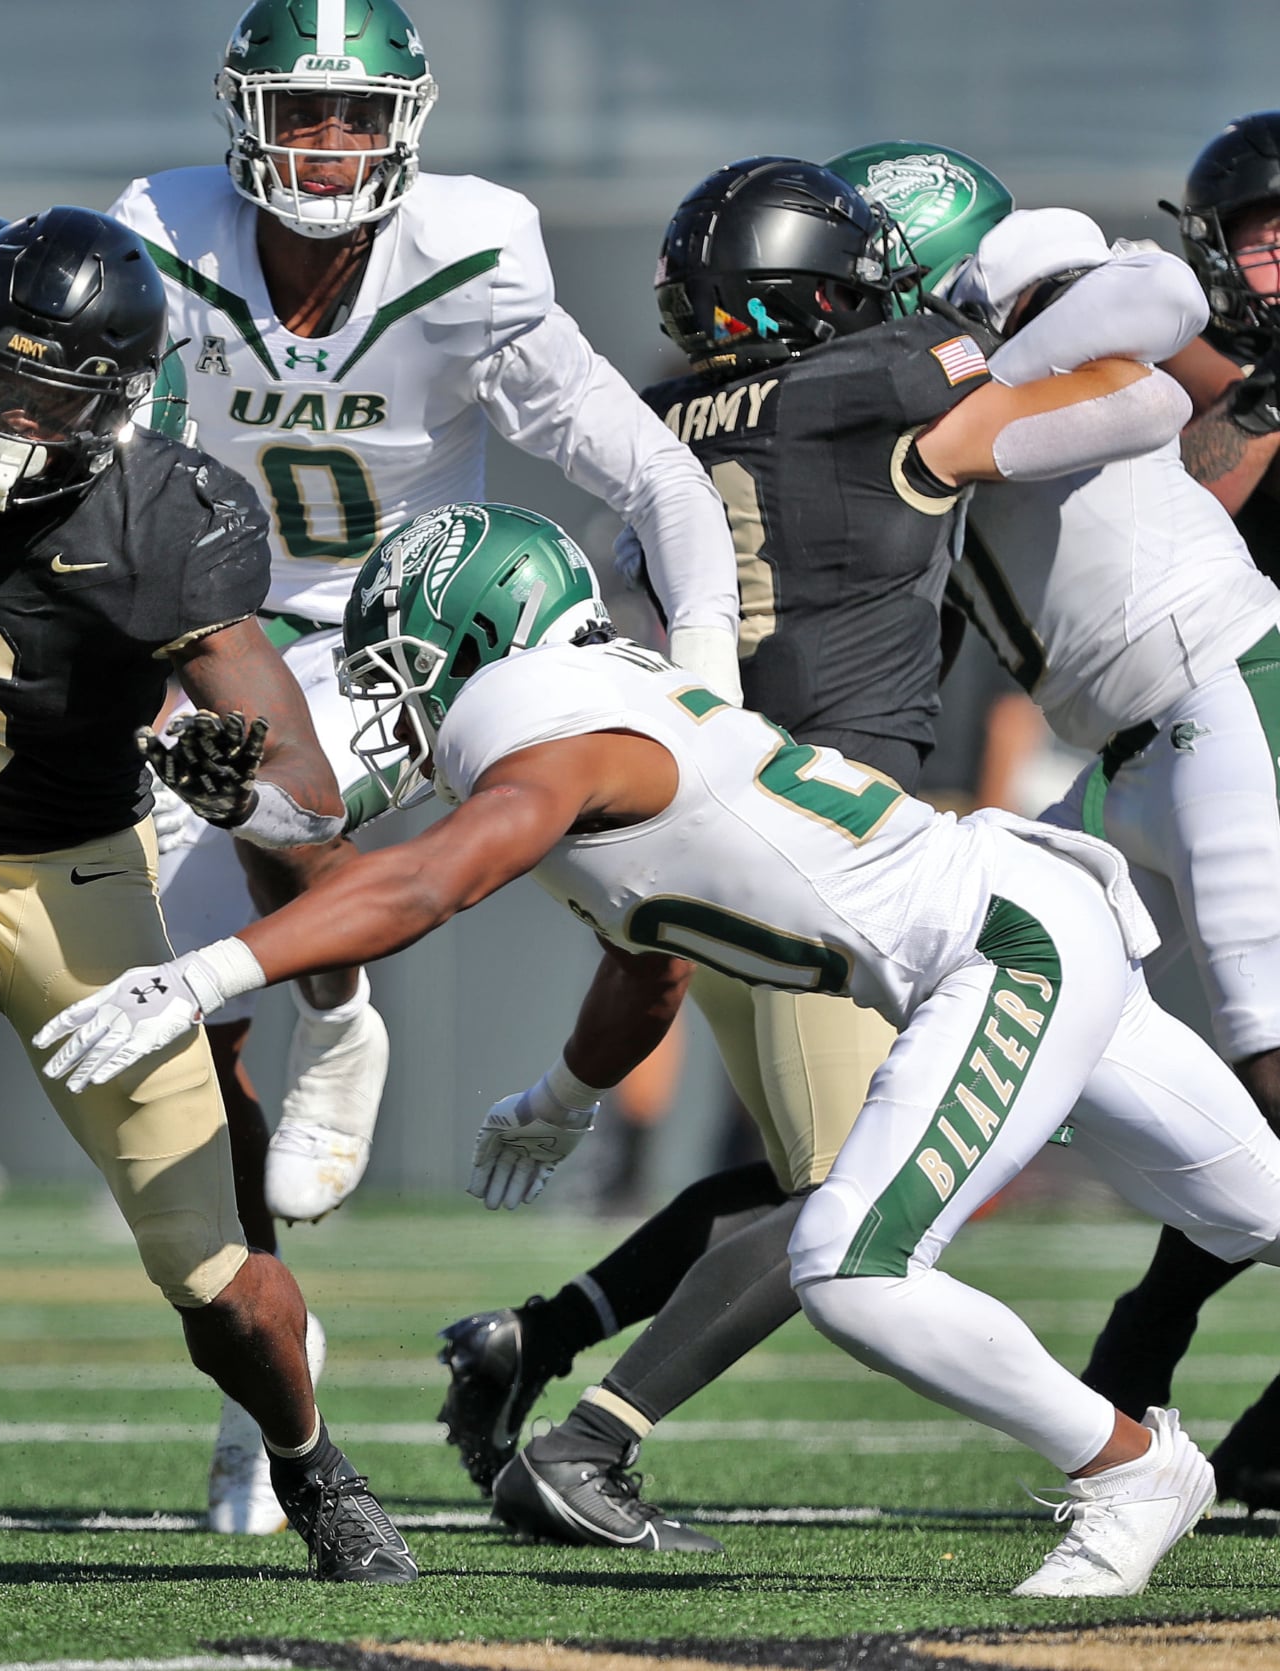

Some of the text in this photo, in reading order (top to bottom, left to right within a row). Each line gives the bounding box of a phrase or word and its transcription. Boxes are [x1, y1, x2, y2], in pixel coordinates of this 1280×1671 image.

[305, 57, 351, 72] UAB
[7, 333, 48, 360] ARMY
[228, 386, 389, 433] UAB
[255, 441, 384, 567] 0
[915, 967, 1054, 1203] BLAZERS
